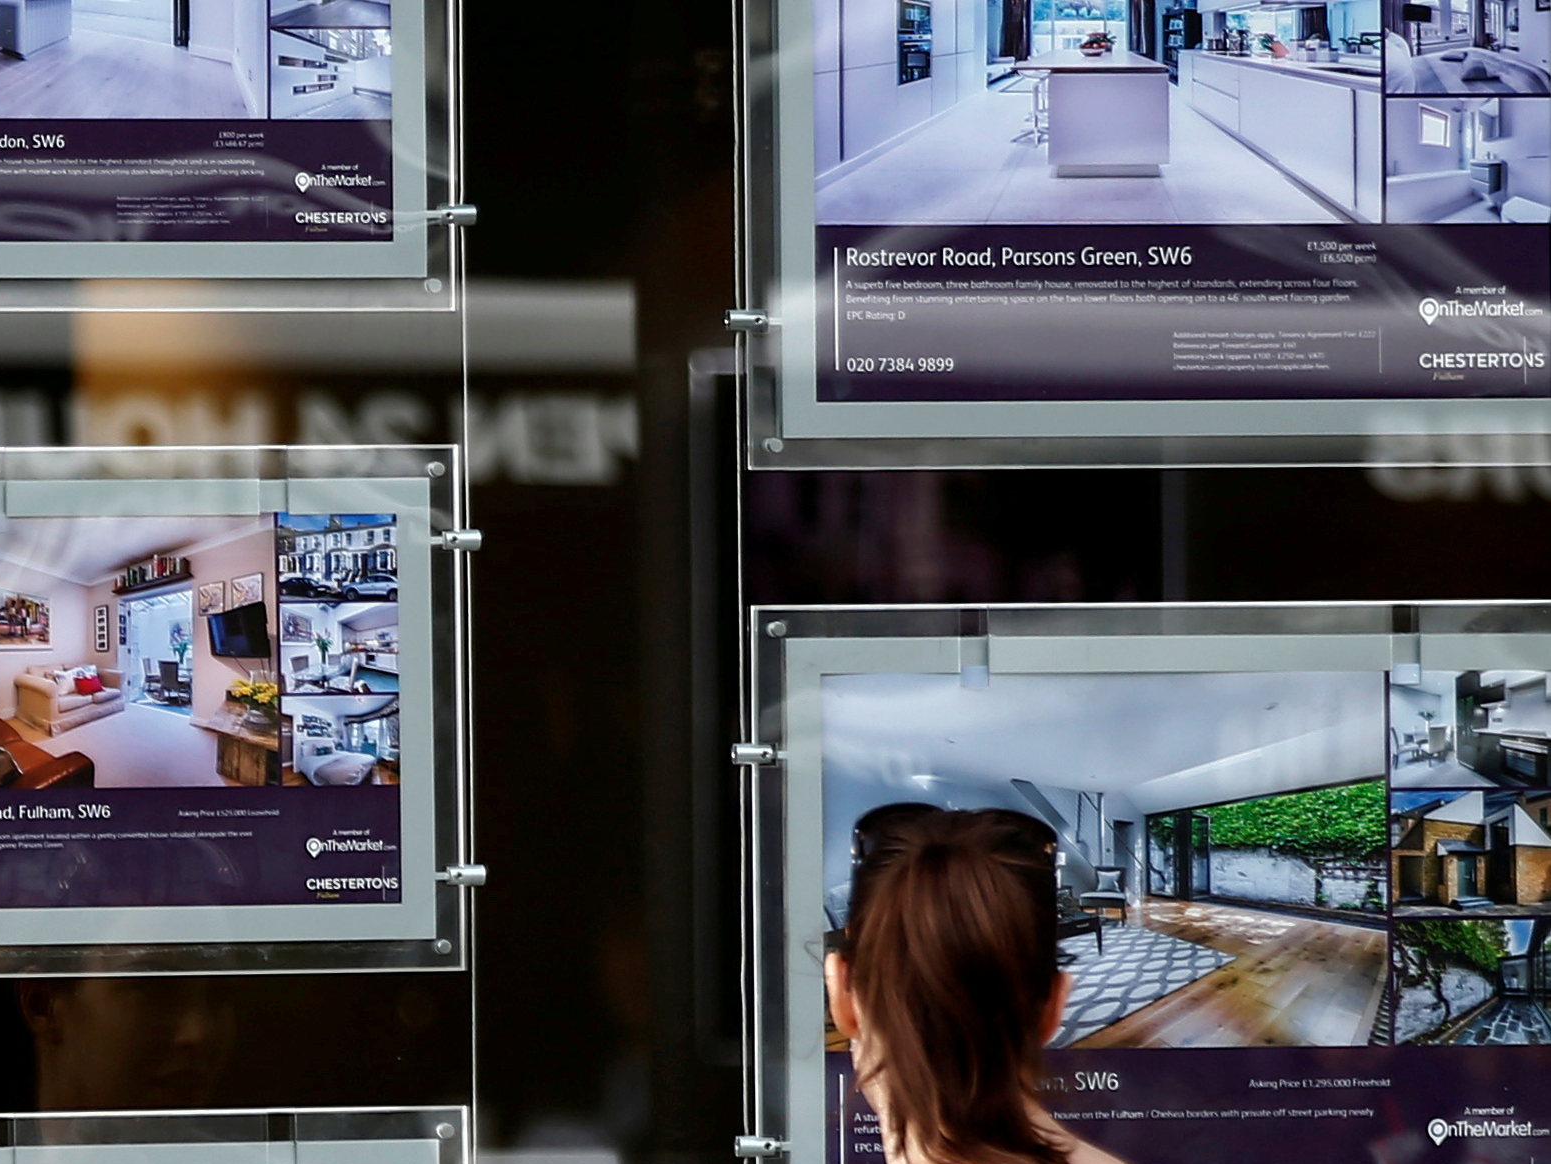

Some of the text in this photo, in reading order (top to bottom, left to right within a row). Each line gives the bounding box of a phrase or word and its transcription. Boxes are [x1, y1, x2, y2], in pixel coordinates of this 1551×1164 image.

[32, 134, 65, 148] SW6
[295, 212, 387, 224] CHESTERTONS
[846, 246, 1192, 267] Rostrevor Road, Parsons Green, SW6
[1455, 285, 1506, 295] A member of
[846, 357, 954, 372] 020 7384 9899
[1420, 353, 1544, 368] CHESTERTONS
[19, 805, 74, 819] Fulham,
[78, 804, 110, 818] SW6
[306, 878, 398, 890] CHESTERTONS
[1074, 1071, 1118, 1090] SW6
[1463, 1106, 1514, 1115] A member of
[854, 1143, 874, 1153] EPC
